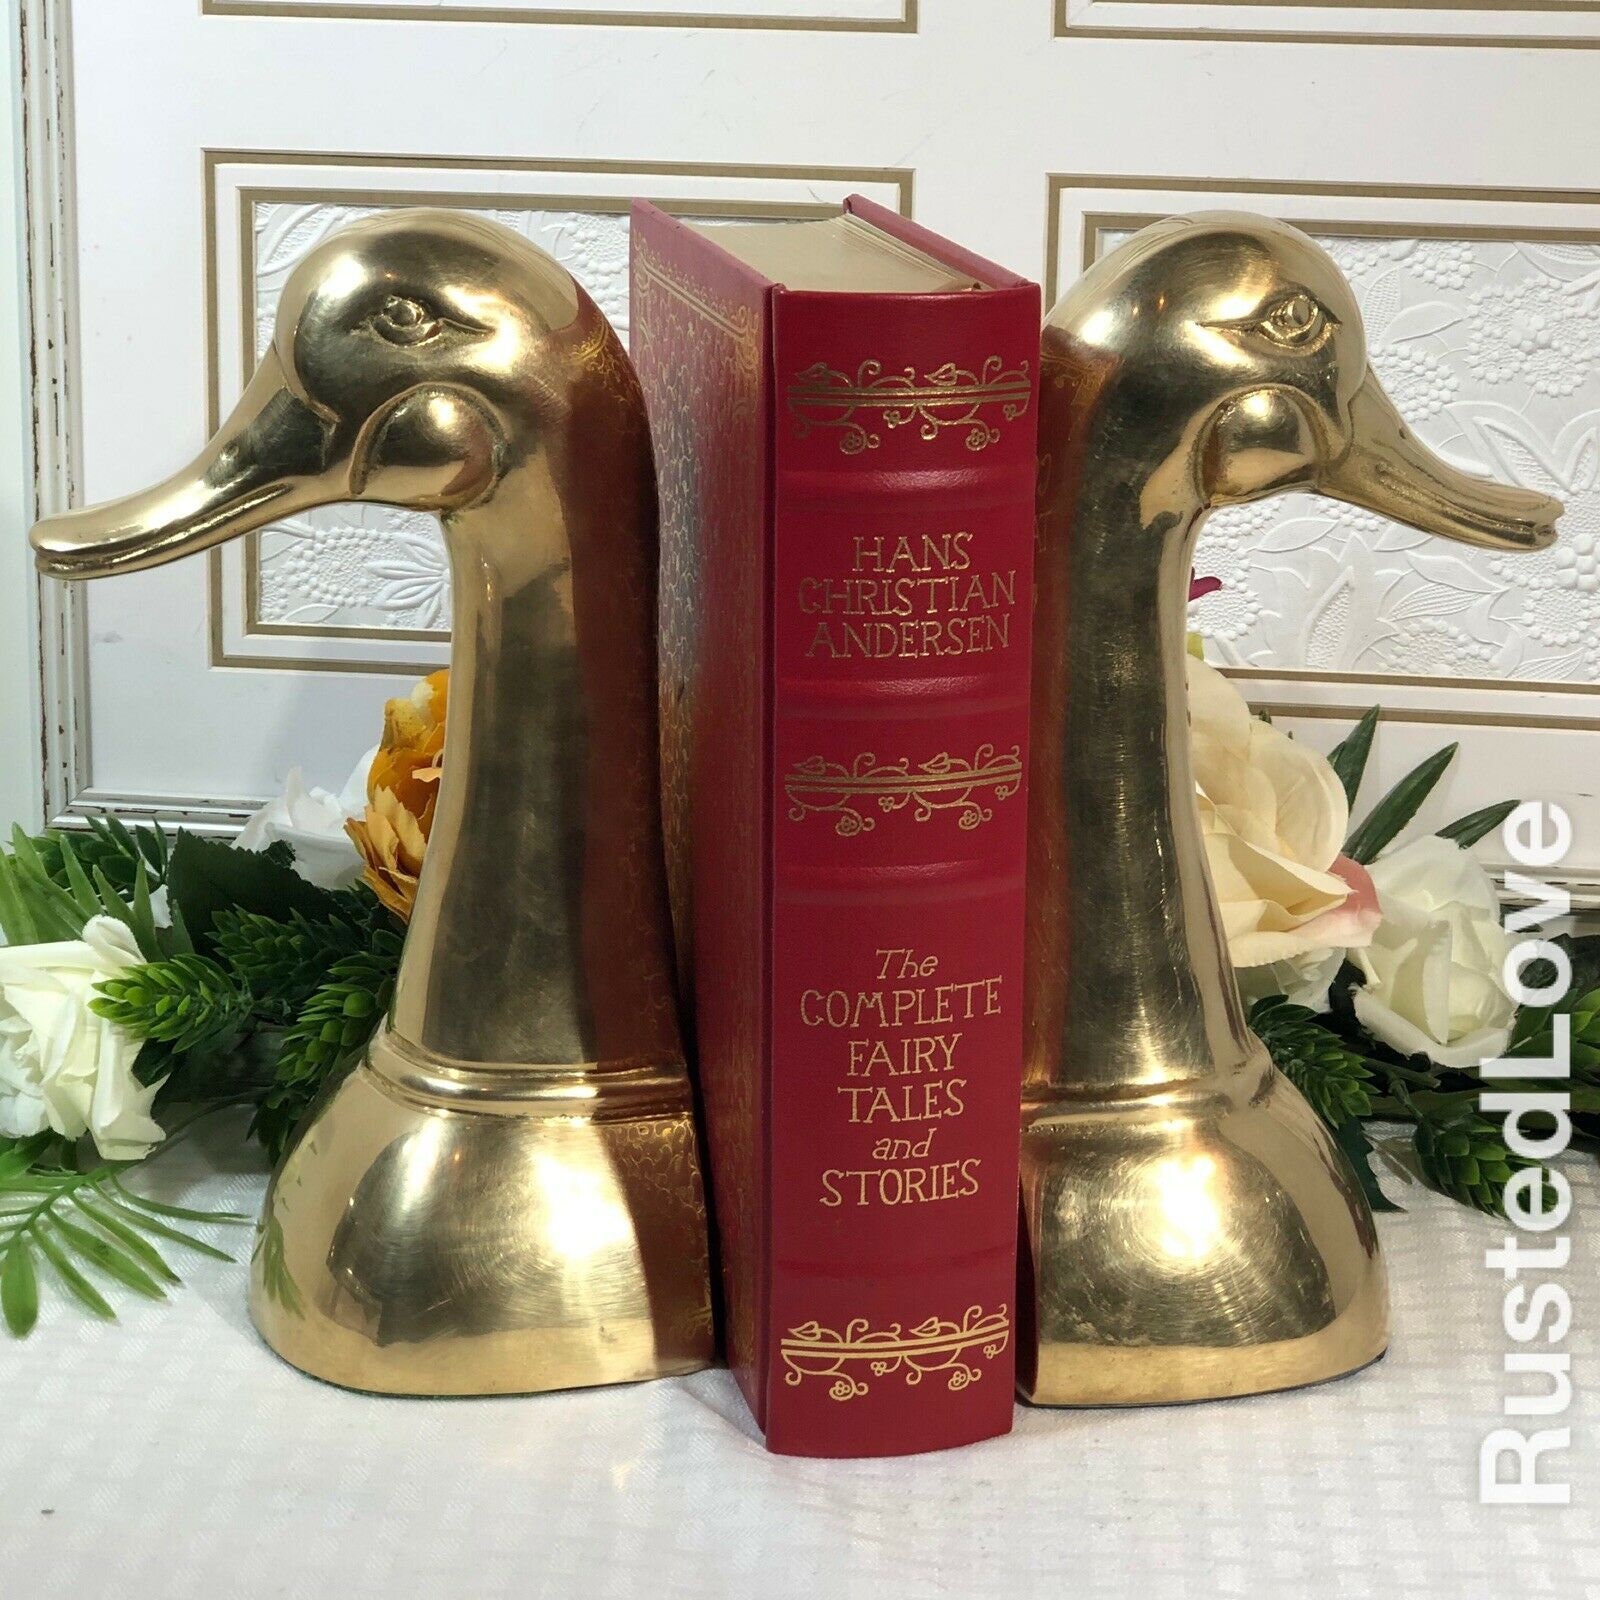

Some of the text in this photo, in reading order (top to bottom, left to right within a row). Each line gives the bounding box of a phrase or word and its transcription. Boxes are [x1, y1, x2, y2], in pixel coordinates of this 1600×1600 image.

[852, 531, 973, 573] HANS
[799, 569, 1017, 616] CHRISTIAN
[804, 613, 1010, 658] ANDERSEN
[876, 948, 939, 980] The
[800, 975, 1002, 1028] COMPLETE
[846, 1032, 963, 1077] FAIRY
[837, 1078, 967, 1124] TALES
[871, 1127, 937, 1160] and
[819, 1158, 982, 1207] STORIES
